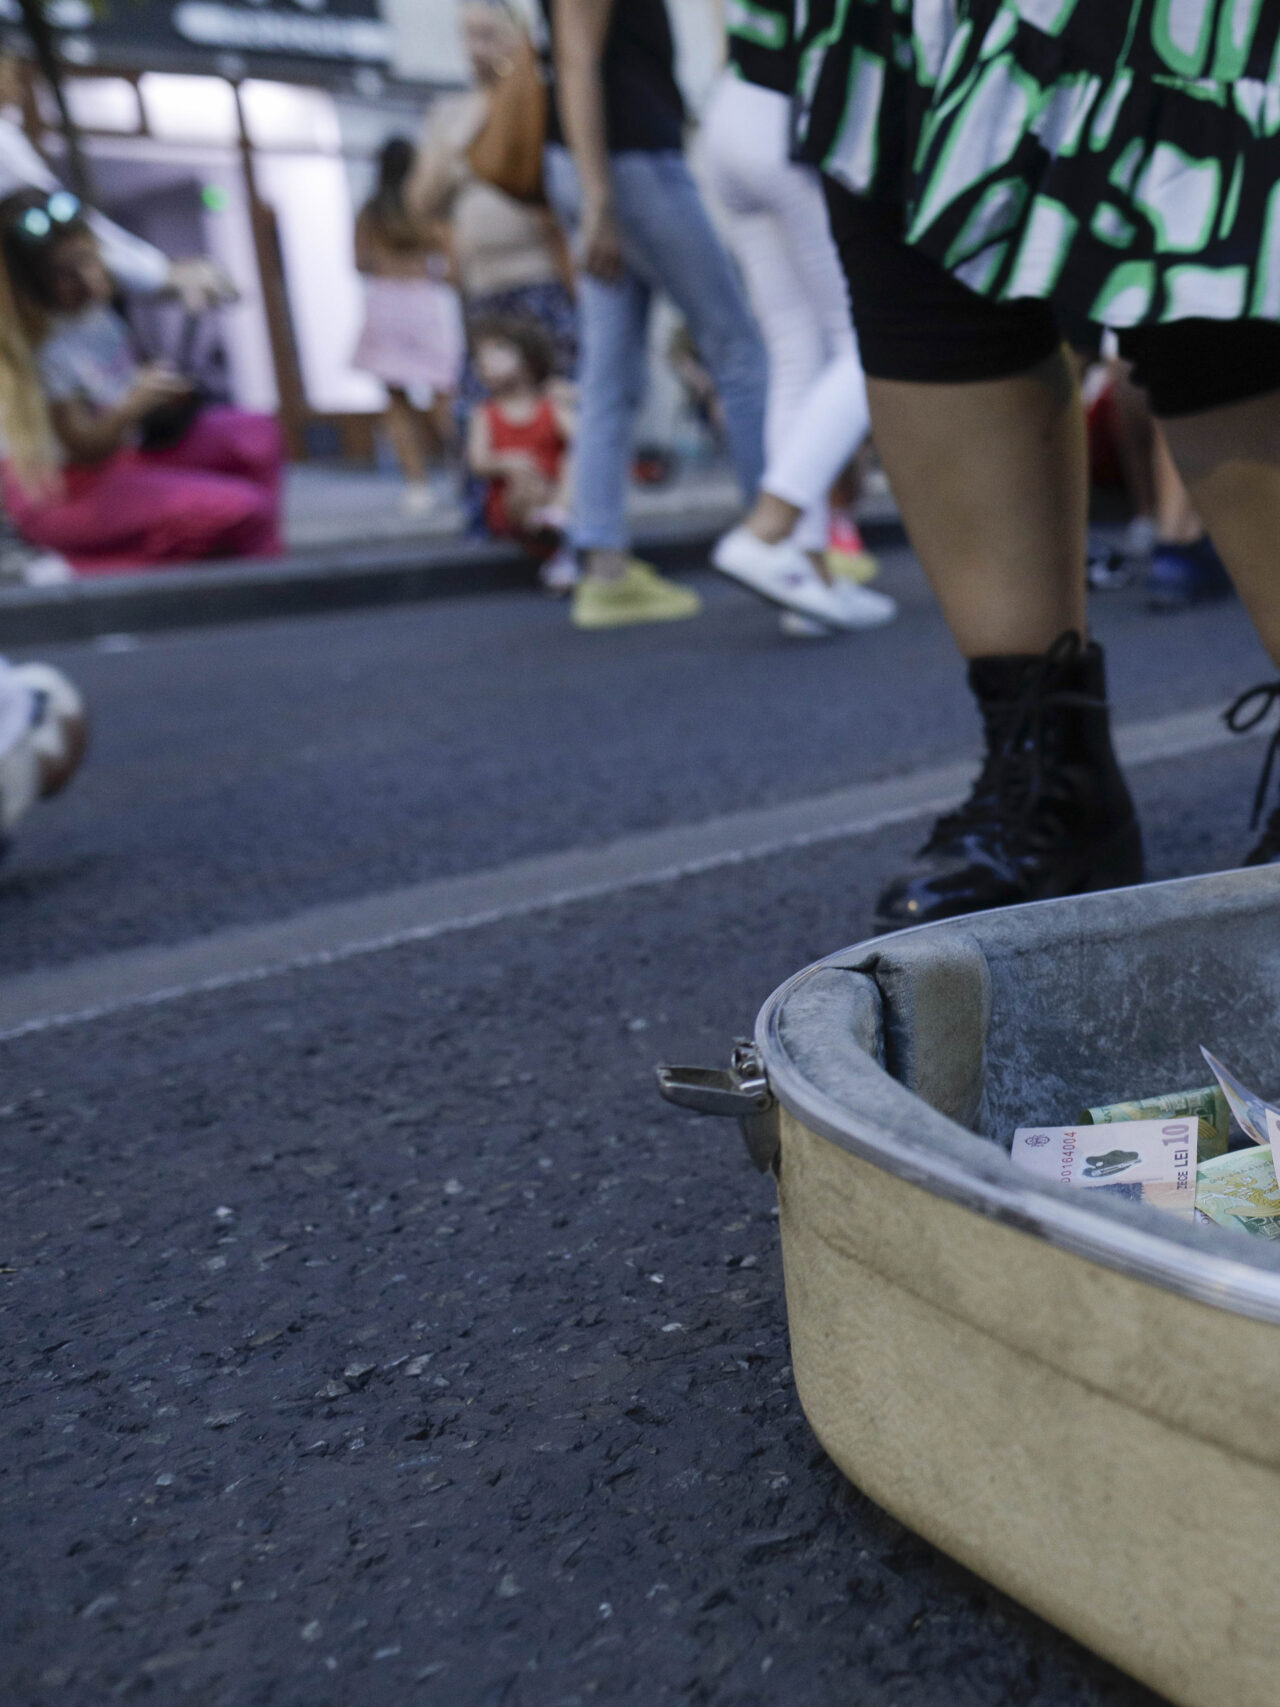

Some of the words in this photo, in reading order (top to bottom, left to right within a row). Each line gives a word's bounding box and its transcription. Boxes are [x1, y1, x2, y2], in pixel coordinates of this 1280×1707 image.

[1162, 1124, 1190, 1147] 10
[1174, 1149, 1189, 1168] LEI
[1176, 1170, 1189, 1191] ZECE
